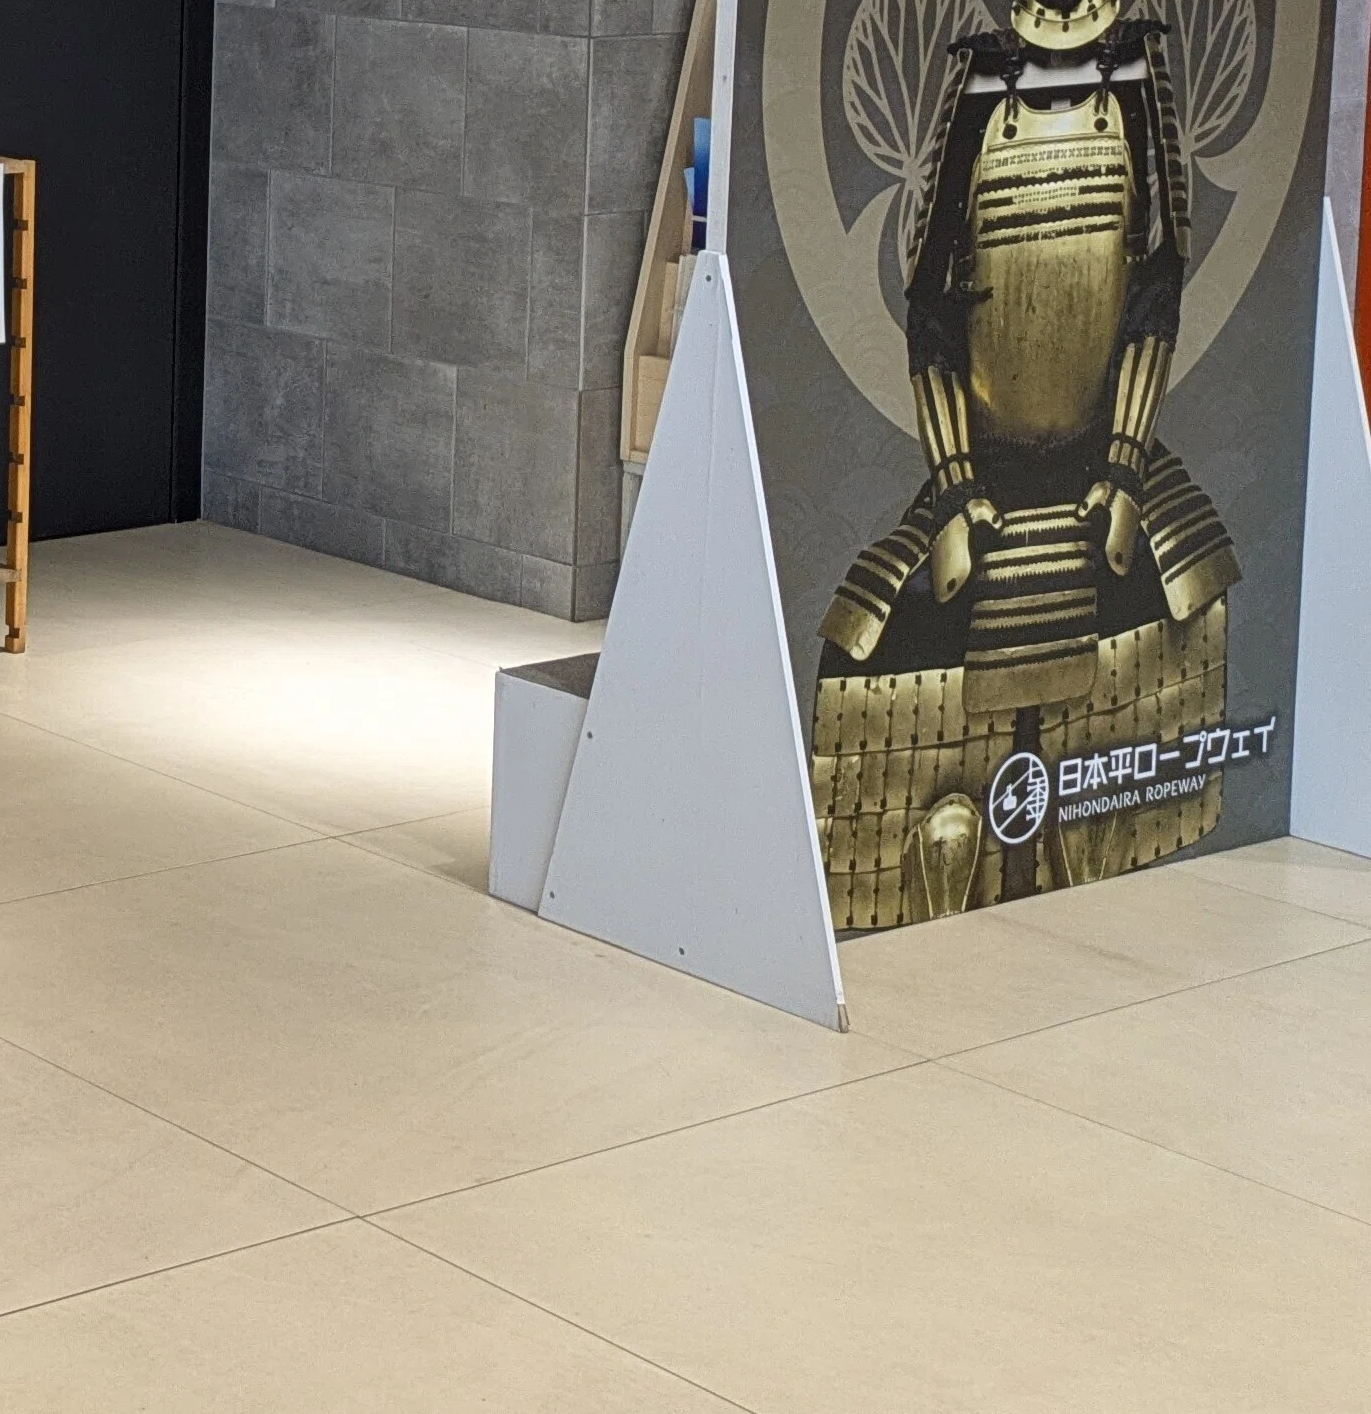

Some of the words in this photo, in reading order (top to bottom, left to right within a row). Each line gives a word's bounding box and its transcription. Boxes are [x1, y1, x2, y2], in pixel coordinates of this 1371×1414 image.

[1058, 715, 1277, 797] 日本平ロープウェイ
[1058, 789, 1142, 823] NIHONDAIRA
[1145, 773, 1208, 802] ROPEWAY
